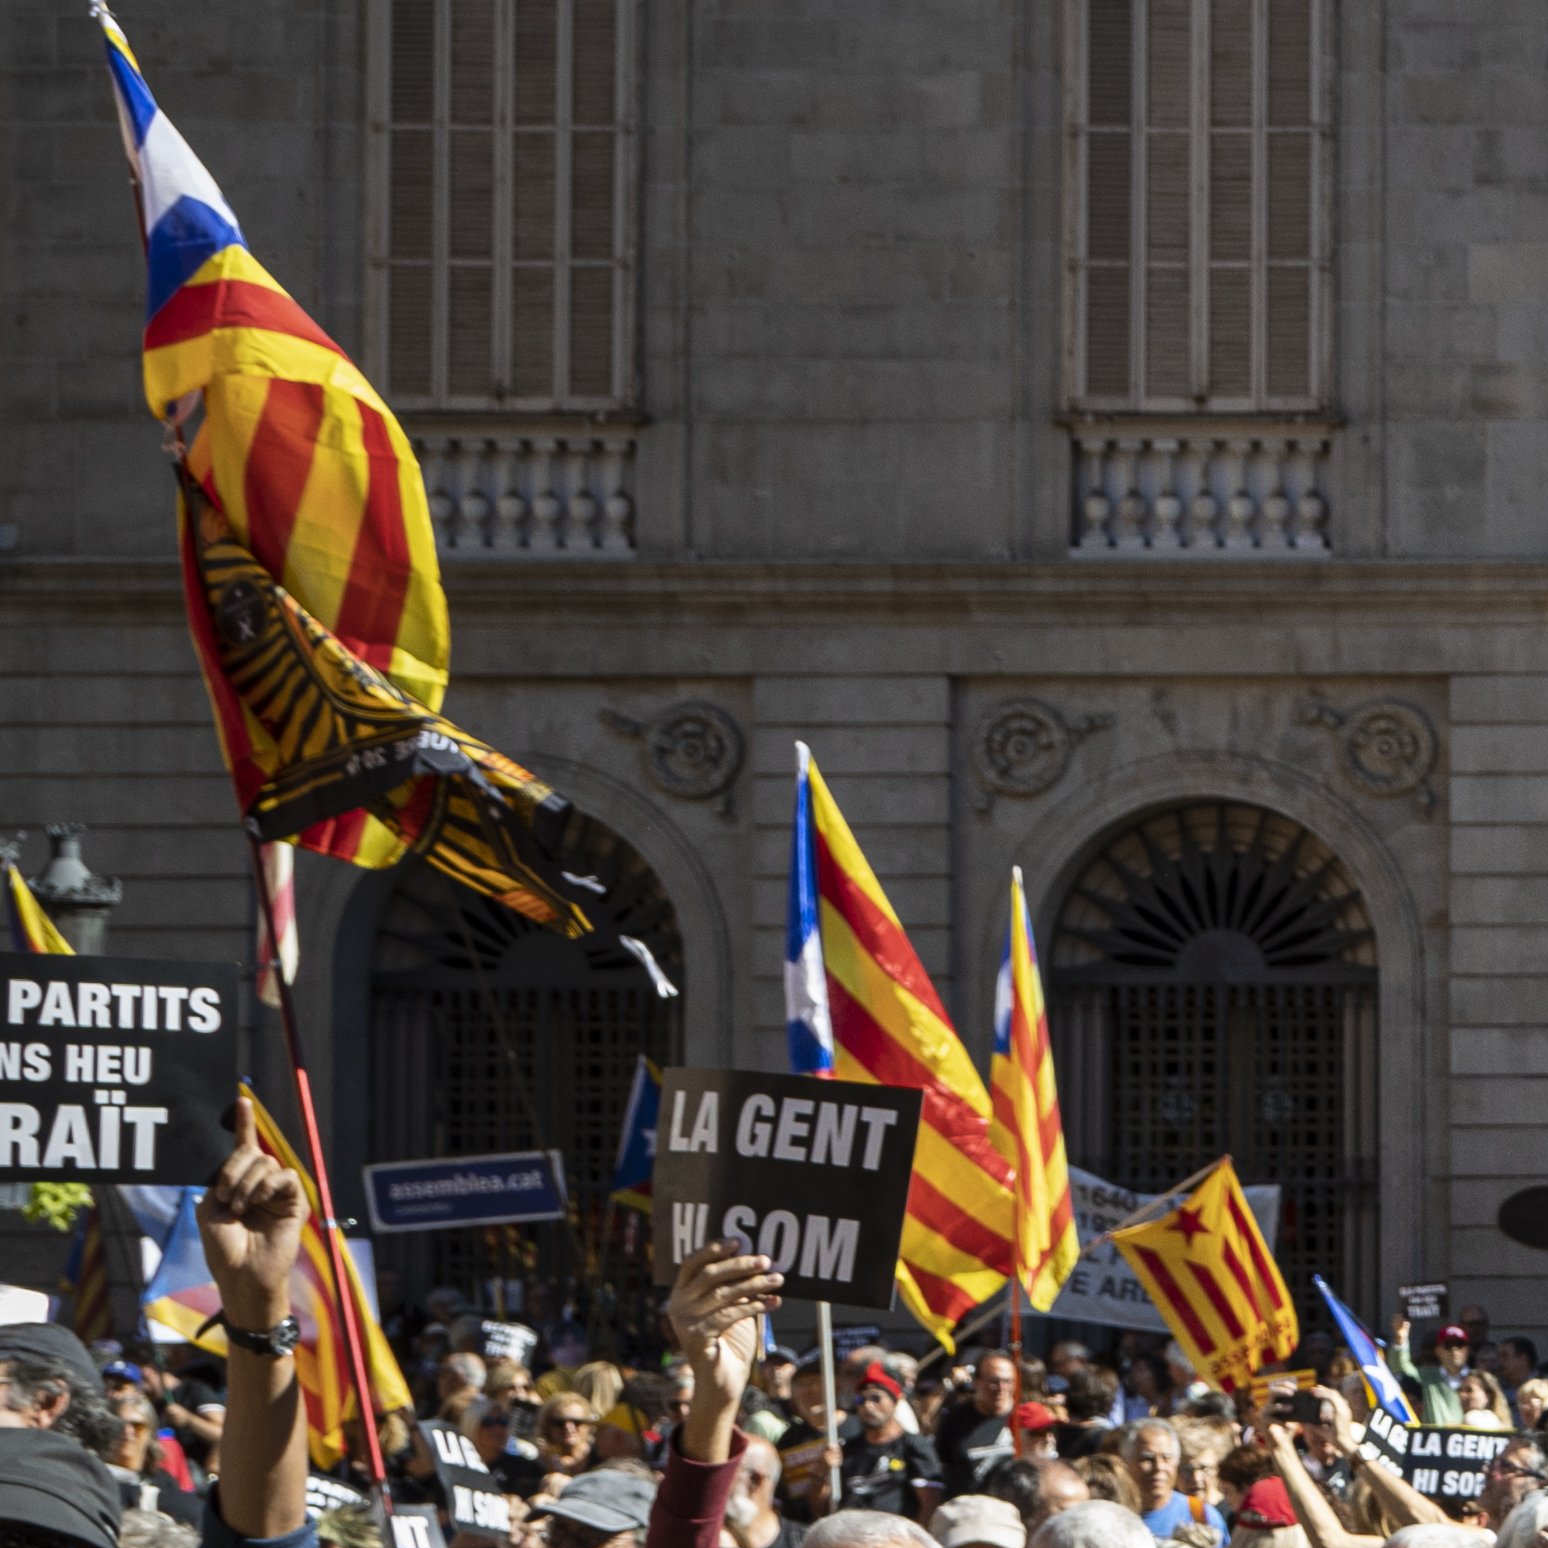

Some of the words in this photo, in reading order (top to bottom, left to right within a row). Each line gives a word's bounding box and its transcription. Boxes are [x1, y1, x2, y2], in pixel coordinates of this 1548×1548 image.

[8, 978, 222, 1034] PARTITS
[65, 1044, 152, 1085] HEU
[0, 1089, 169, 1170] RAÏT
[669, 1090, 719, 1154] LA
[735, 1093, 899, 1171] GENT
[389, 1169, 544, 1201] assemblea.cat
[672, 1202, 709, 1265] HI
[722, 1204, 860, 1283] SOM
[1411, 1432, 1442, 1456] LA
[1447, 1433, 1509, 1460] GENT
[1413, 1468, 1439, 1494] HI
